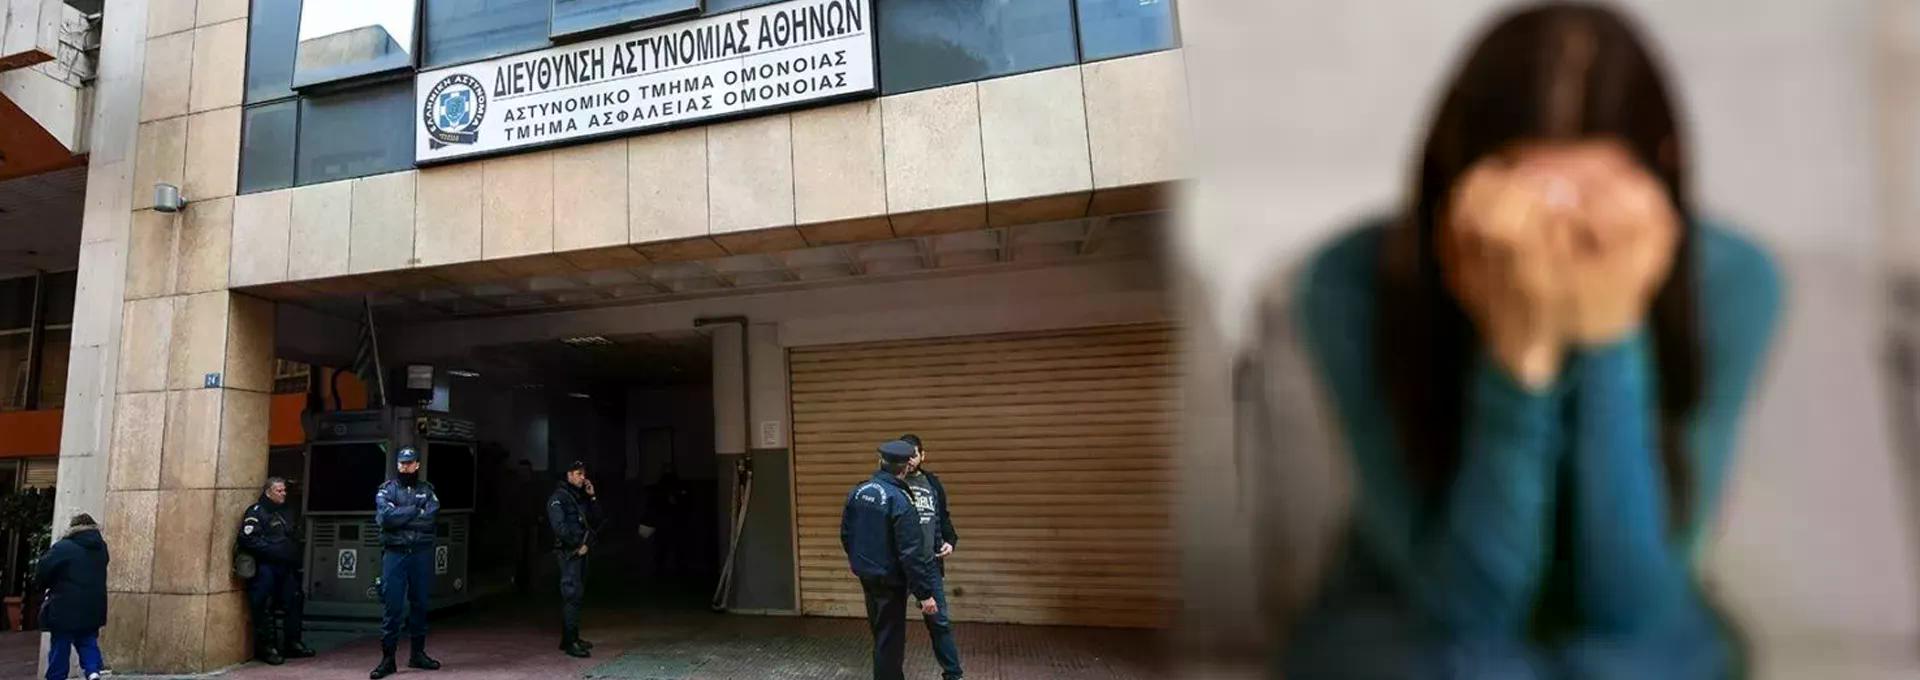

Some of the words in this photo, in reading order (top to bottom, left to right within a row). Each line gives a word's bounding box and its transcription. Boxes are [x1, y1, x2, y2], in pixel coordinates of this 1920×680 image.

[493, 46, 605, 97] ΔΙΕΥΘΥΝΣΗ
[611, 18, 751, 77] ΑΣΤΥΝΟΜΙΑΣ
[757, 0, 863, 50] ΑΘΗΝΩΝ
[504, 89, 630, 122] ΑΣΤΥΝΟΜΙΚΟ
[638, 75, 714, 99] ΤΜΗΜΑ
[723, 50, 847, 86] ΟΜΟΝΟΙΑΣ
[505, 118, 578, 141] ΤΜΗΜΑ
[588, 95, 712, 128] ΑΣΦΑΛΕΙΑΣ
[723, 72, 847, 106] ΟΜΟΝΟΙΑΣ
